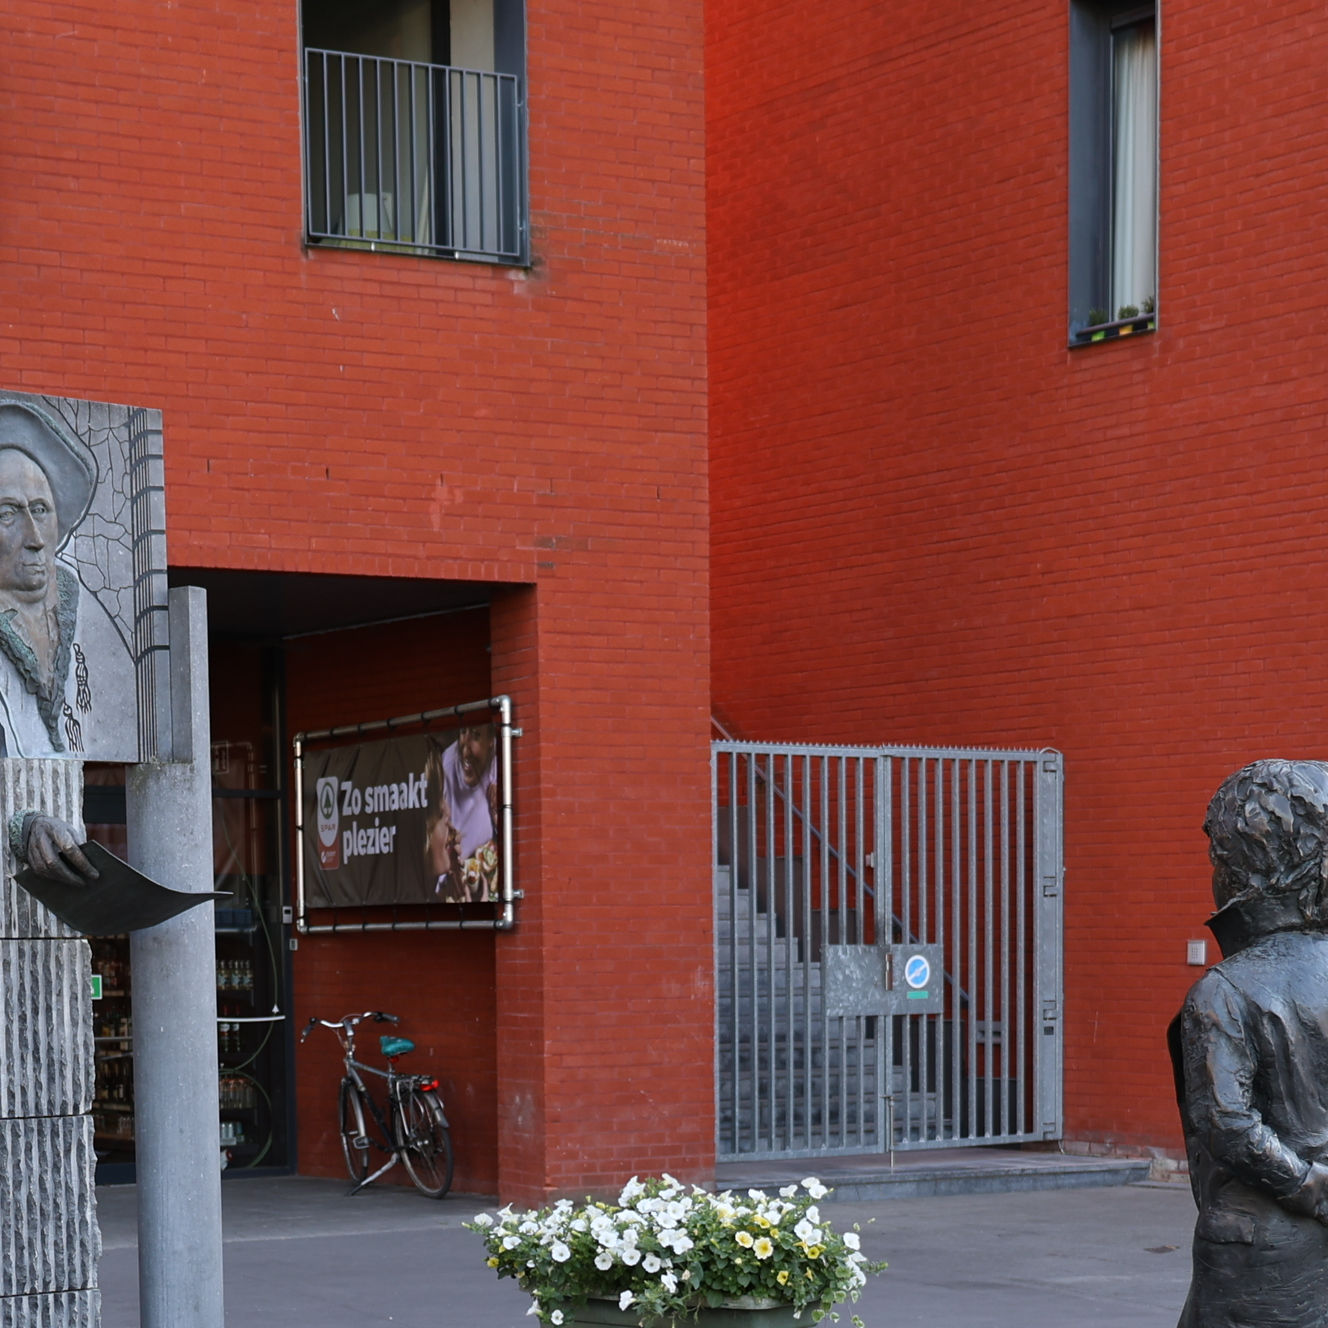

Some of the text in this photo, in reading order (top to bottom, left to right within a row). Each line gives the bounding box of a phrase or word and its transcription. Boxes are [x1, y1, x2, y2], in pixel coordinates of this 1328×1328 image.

[340, 772, 428, 816] Zo smaakt
[343, 816, 396, 865] plezier
